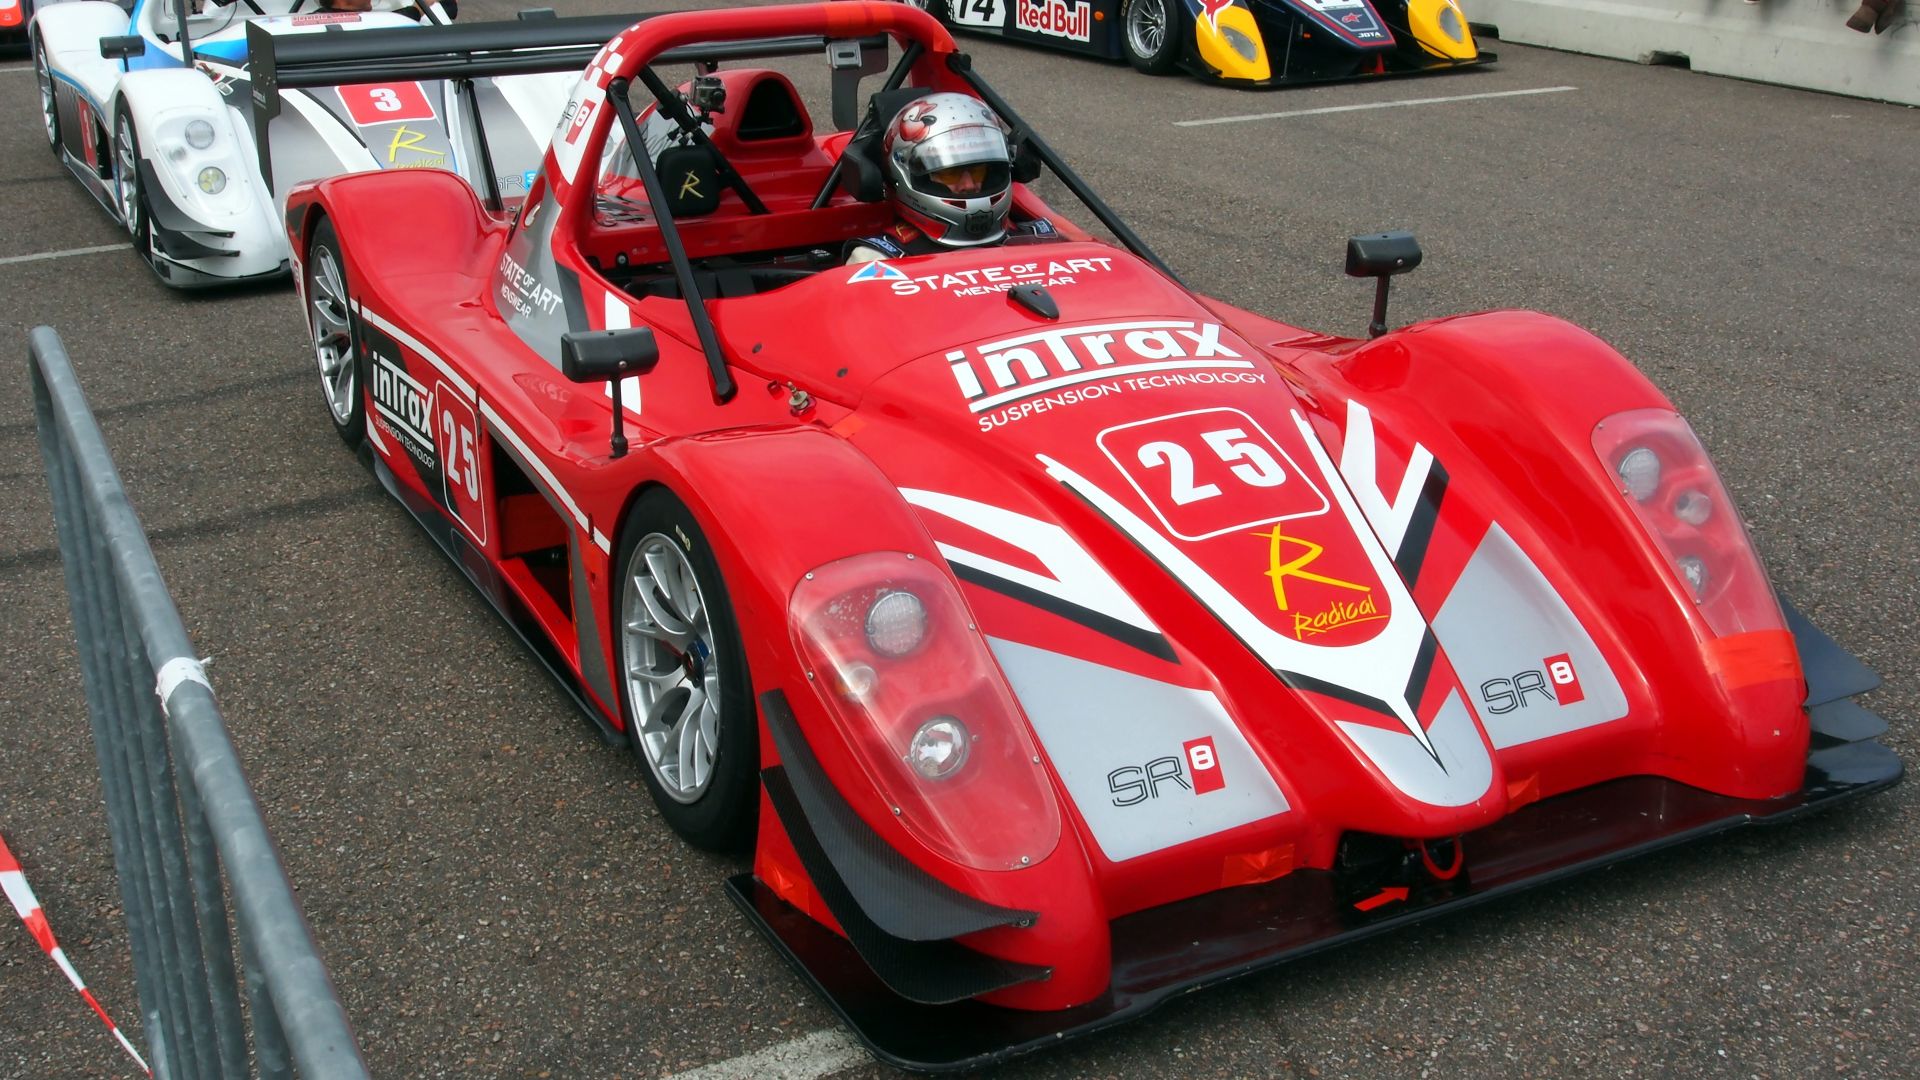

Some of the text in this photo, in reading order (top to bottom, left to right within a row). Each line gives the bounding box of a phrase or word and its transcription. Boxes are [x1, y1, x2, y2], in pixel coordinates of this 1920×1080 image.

[1018, 0, 1050, 30] Red
[1053, 3, 1088, 37] Bull
[369, 88, 402, 112] 3
[500, 252, 563, 316] STATE OF ART
[500, 283, 533, 319] MENSWEAR
[890, 257, 1112, 297] STATE OF ART
[978, 371, 1266, 433] SUSPENSION TECHNOLOGY
[374, 414, 435, 470] SUSPENSION TECHNOLOGY
[443, 409, 479, 502] 25
[1137, 428, 1287, 506] 25
[1290, 594, 1378, 640] Radical
